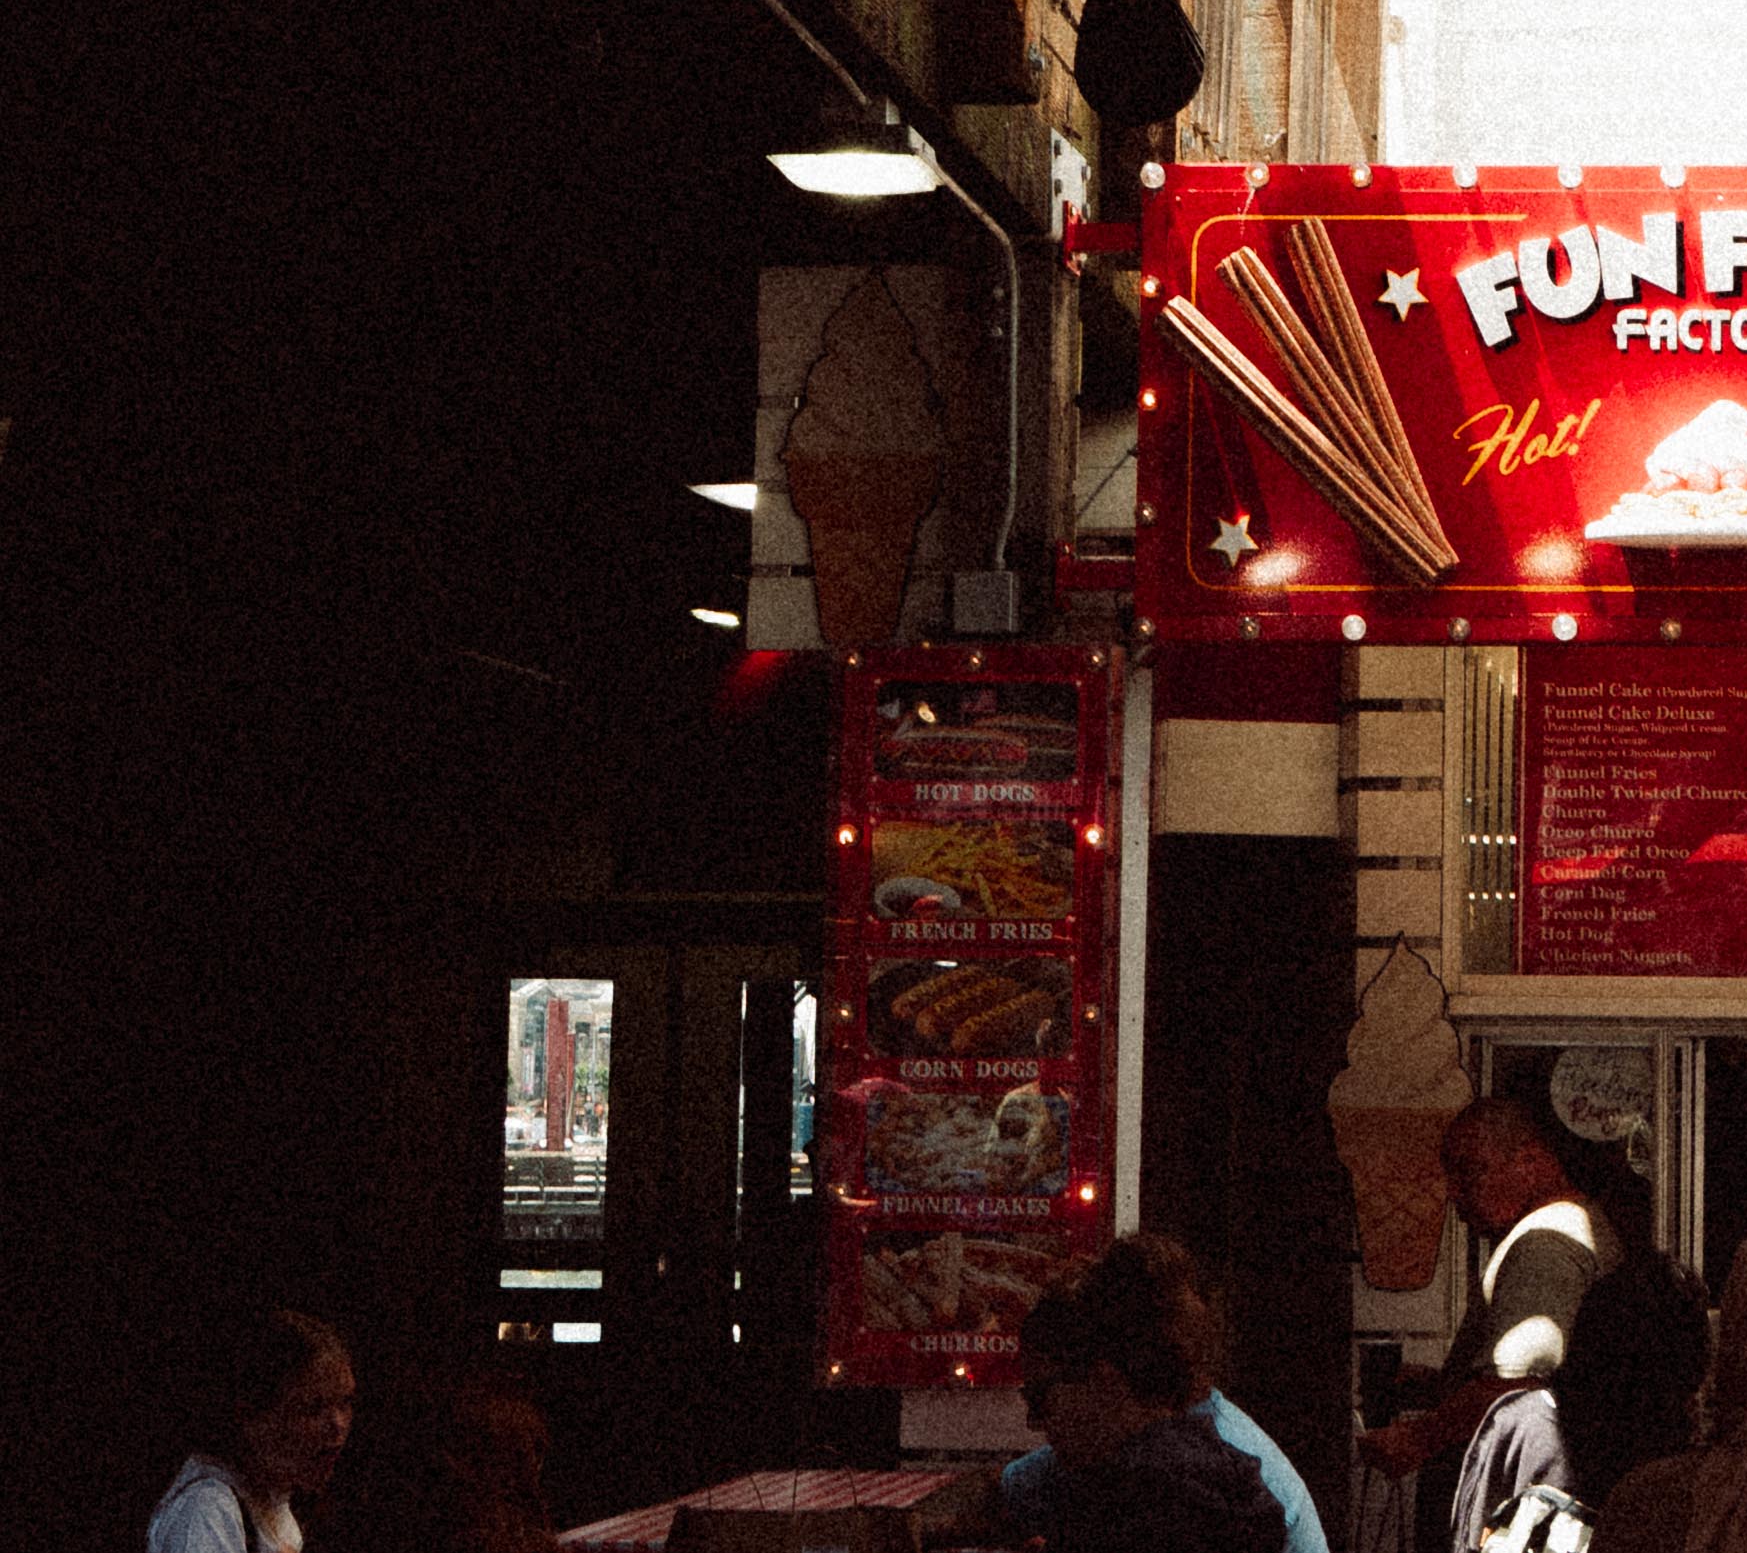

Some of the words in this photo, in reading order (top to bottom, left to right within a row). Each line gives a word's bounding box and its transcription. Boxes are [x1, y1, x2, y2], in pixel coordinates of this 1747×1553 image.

[1455, 212, 1685, 347] FUN
[1452, 398, 1602, 487] Hot!
[1543, 682, 1604, 697] Funnel
[1609, 683, 1652, 697] Cake
[1543, 705, 1604, 720] Funnel
[1609, 705, 1651, 720] Cake
[1656, 705, 1715, 720] Deluxe
[1543, 766, 1605, 780] Funnel
[1611, 766, 1657, 780] Fries
[915, 784, 962, 802] HOT
[973, 784, 1035, 802] DOGS
[1543, 786, 1606, 800] Double
[1611, 786, 1681, 800] Twisted
[1542, 805, 1607, 819] Churro
[1541, 825, 1586, 839] Oreo
[1591, 825, 1655, 839] Churro
[1542, 845, 1587, 862] Deep
[1591, 845, 1642, 859] Fried
[1646, 845, 1690, 859] Oreo
[1541, 865, 1616, 879] Caramel
[1622, 866, 1666, 879] Corn
[1540, 886, 1585, 899] Corn
[1591, 887, 1626, 903] Dog
[1540, 907, 1605, 921] French
[1610, 907, 1656, 921] Fries
[889, 923, 976, 940] FRENCH
[986, 924, 1054, 939] FRIES
[1540, 927, 1573, 941] Hot
[1579, 928, 1615, 944] Dog
[1540, 949, 1614, 962] Chicken
[1620, 949, 1692, 966] Nuggets
[899, 1061, 964, 1077] CORN
[976, 1061, 1040, 1078] DOGS
[882, 1197, 967, 1215] FUNNEL
[978, 1197, 1051, 1216] CAKES
[909, 1335, 1019, 1353] CHURROS
